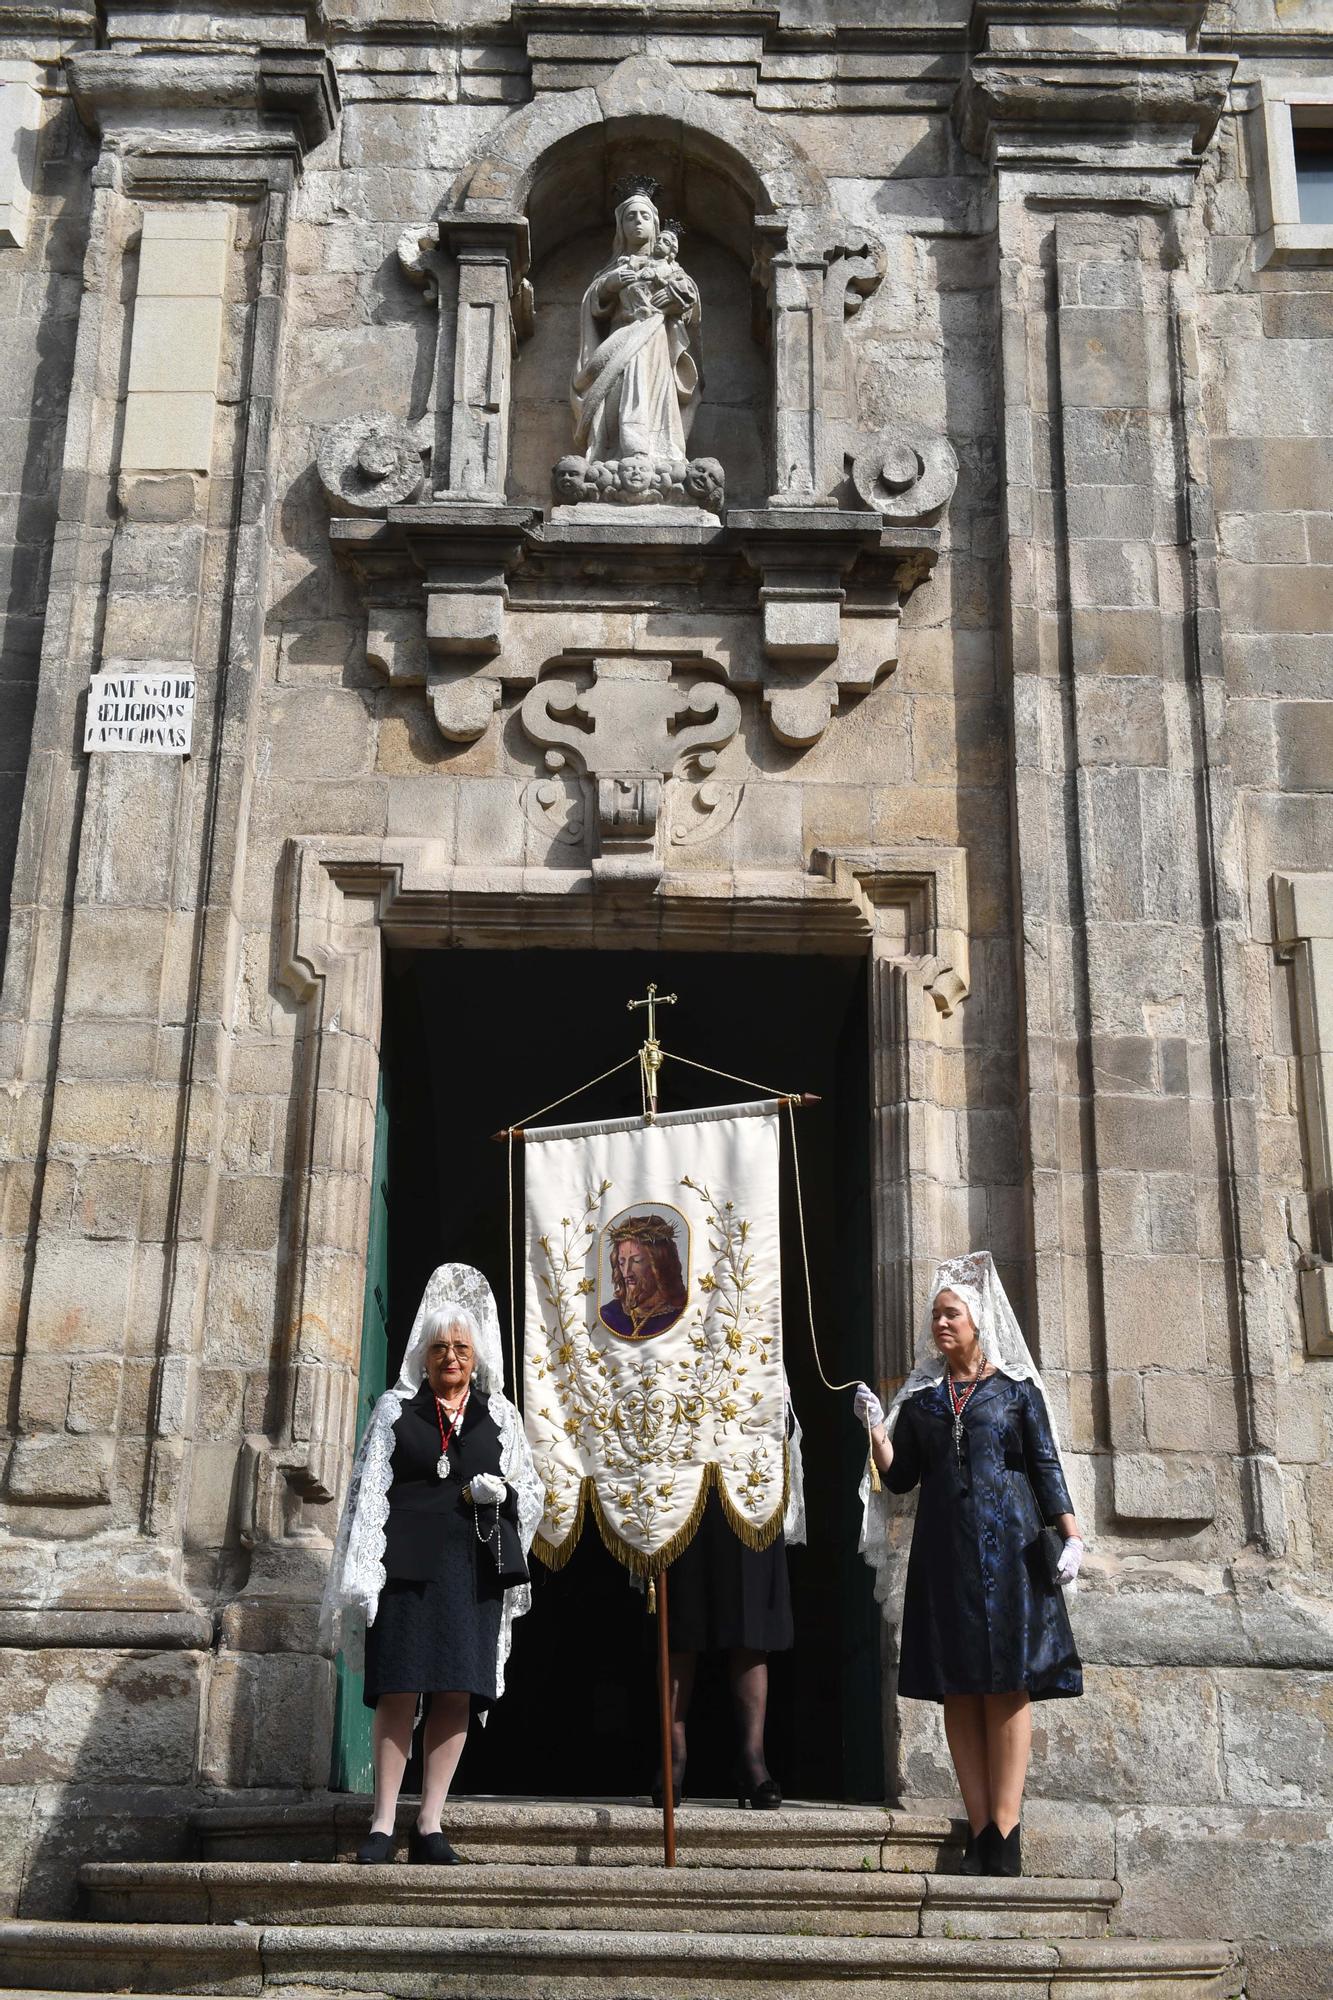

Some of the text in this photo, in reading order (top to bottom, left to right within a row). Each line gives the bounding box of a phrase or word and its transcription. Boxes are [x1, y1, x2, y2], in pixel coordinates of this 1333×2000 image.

[88, 679, 195, 699] ONVETO DE
[98, 703, 185, 722] RELIGIOSAS
